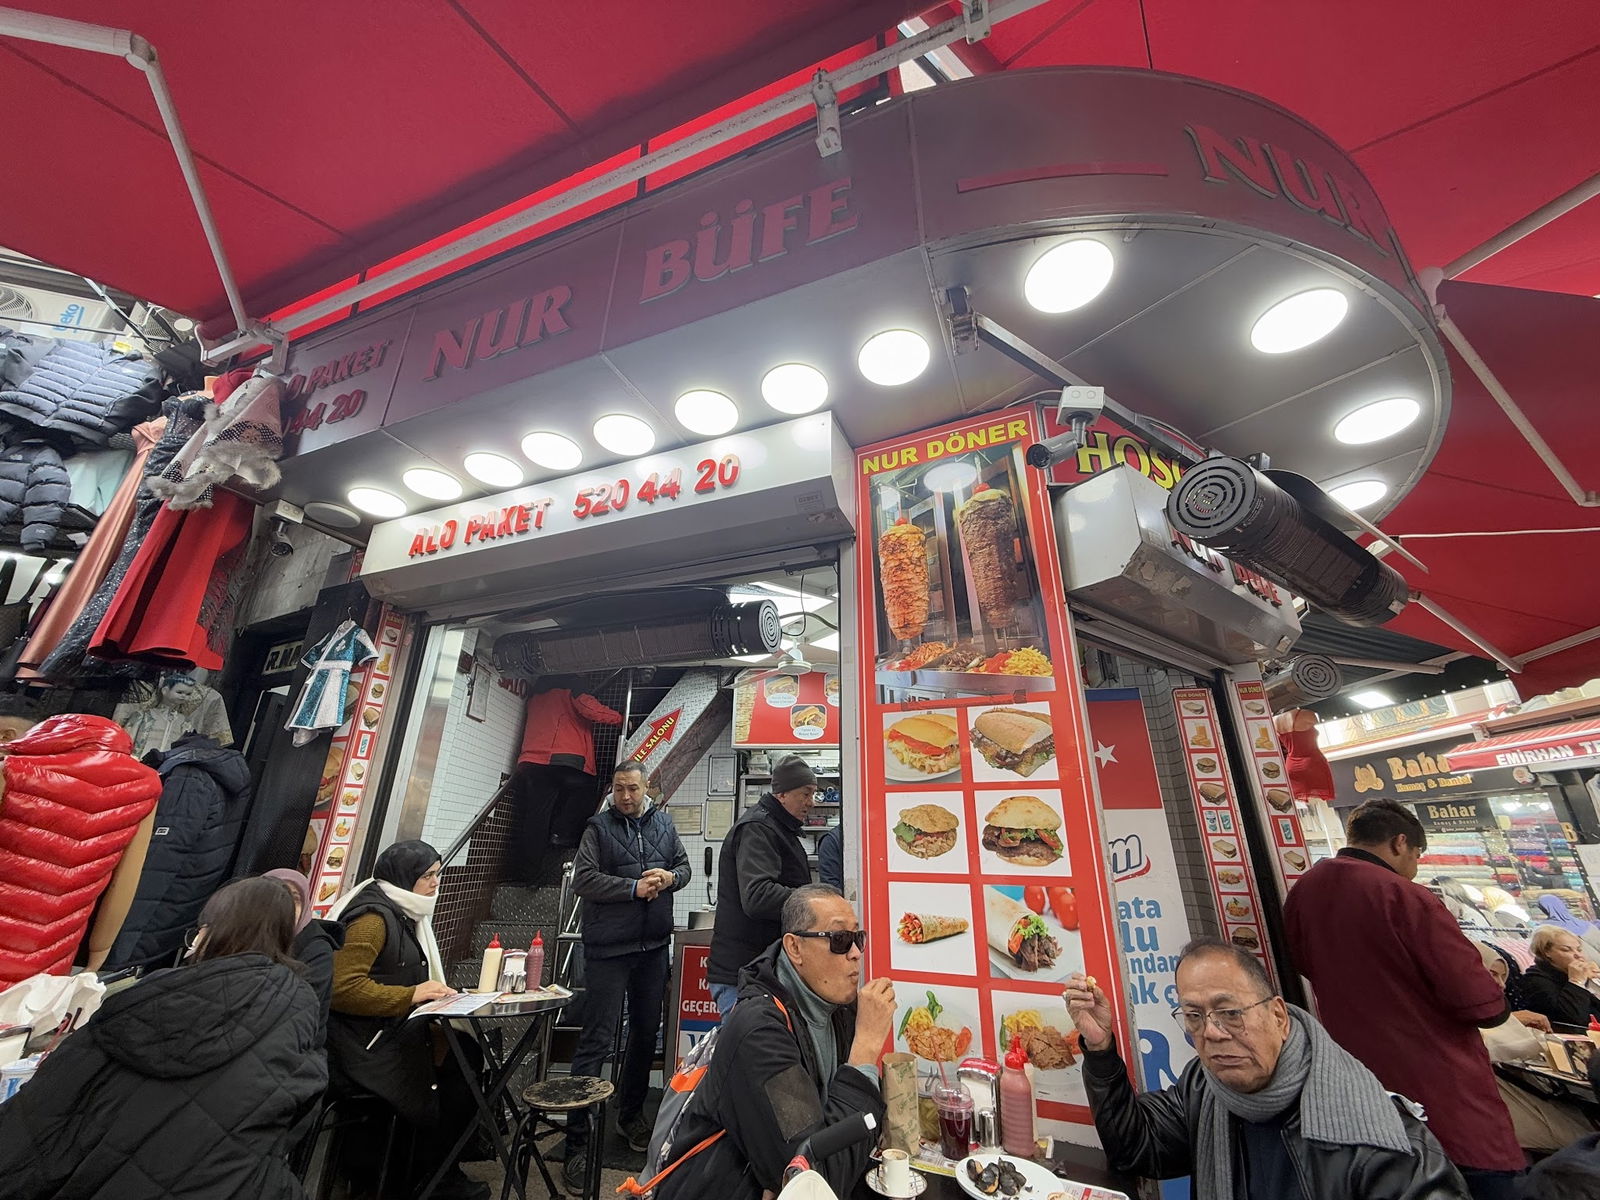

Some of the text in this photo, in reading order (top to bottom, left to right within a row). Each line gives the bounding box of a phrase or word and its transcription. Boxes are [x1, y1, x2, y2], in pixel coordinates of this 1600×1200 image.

[1184, 122, 1391, 258] NUR
[421, 177, 859, 382] NUR BÜFE
[305, 338, 391, 394] PAKET
[325, 389, 368, 424] 20
[863, 419, 1029, 475] NUR DÖNER
[1076, 430, 1182, 490] HOS
[408, 454, 741, 558] ALO PAKET 520 44 20
[645, 716, 675, 749] SALONU
[1496, 744, 1574, 766] EMİRHAN
[1386, 752, 1451, 780] Baha
[1427, 803, 1476, 819] Bahar
